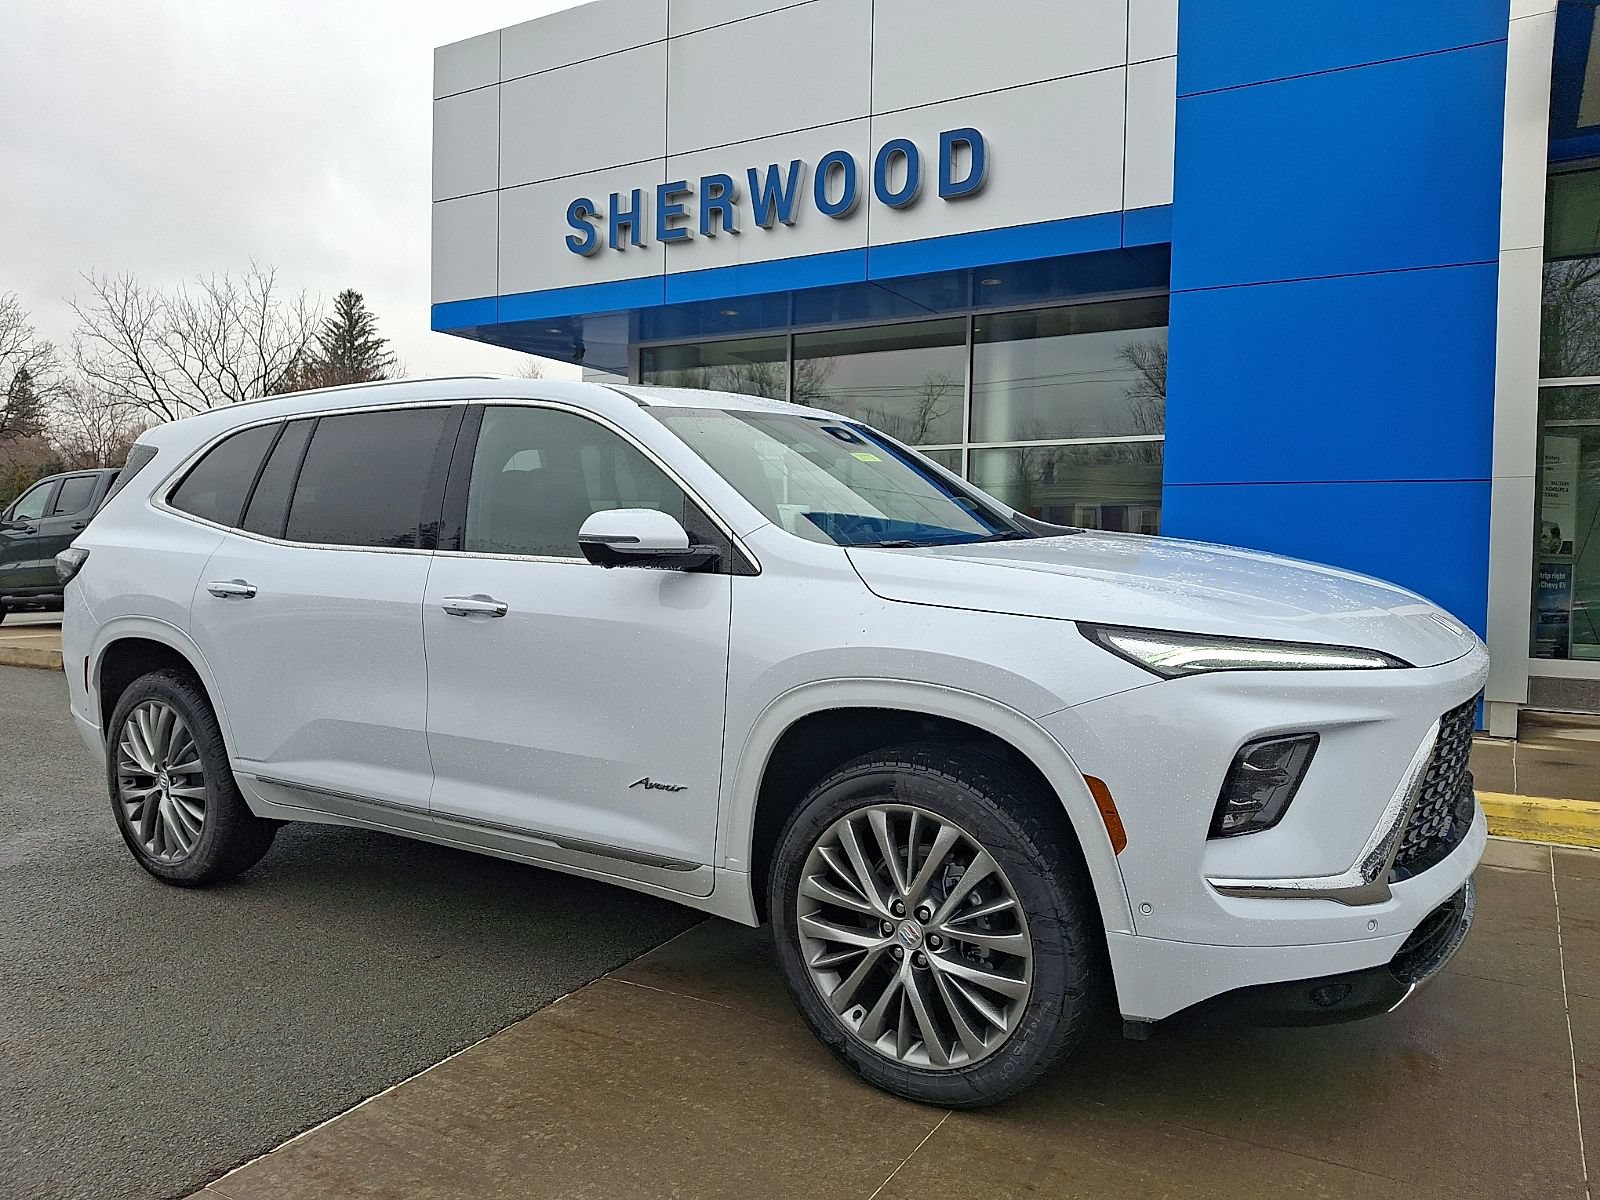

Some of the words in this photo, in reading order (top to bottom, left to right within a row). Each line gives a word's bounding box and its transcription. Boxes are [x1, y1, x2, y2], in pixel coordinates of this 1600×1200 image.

[565, 127, 988, 258] SHERWOOD
[1551, 572, 1566, 580] right
[1540, 581, 1559, 589] Chevy
[1559, 581, 1567, 589] EV
[628, 777, 689, 792] Avenir
